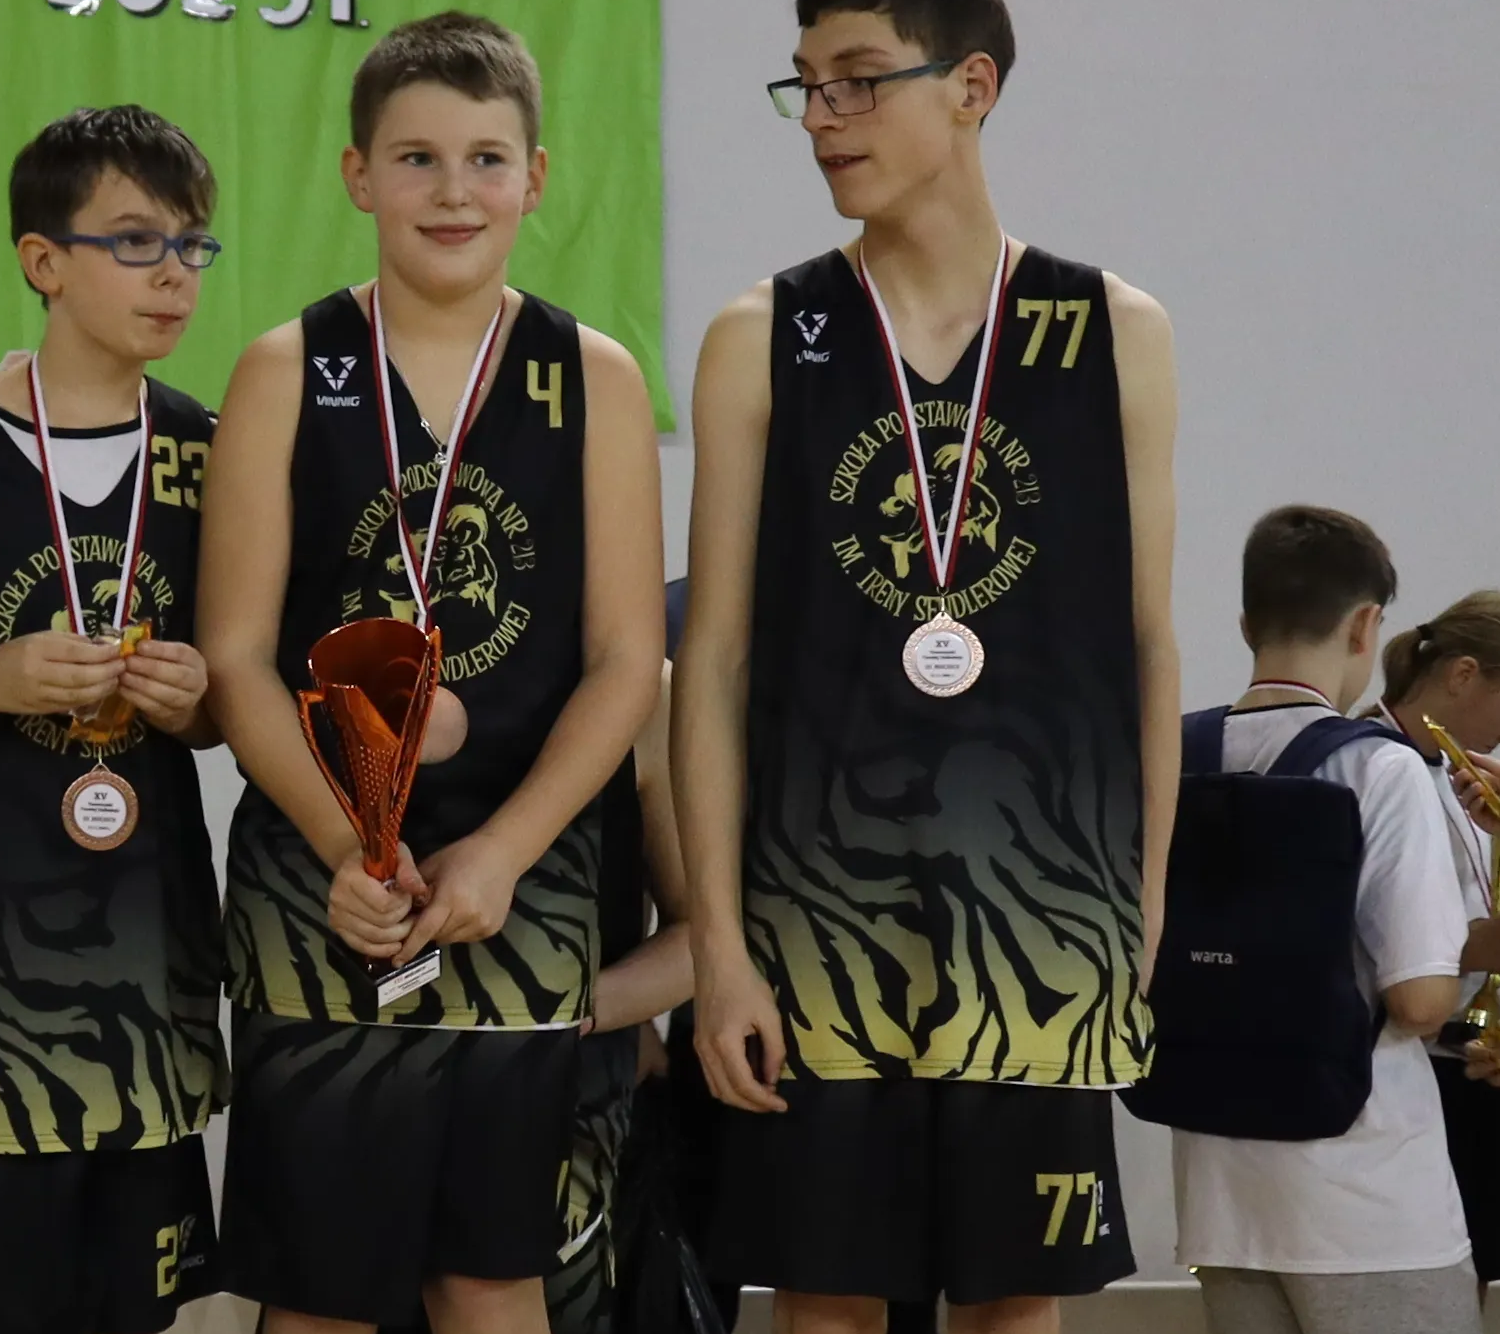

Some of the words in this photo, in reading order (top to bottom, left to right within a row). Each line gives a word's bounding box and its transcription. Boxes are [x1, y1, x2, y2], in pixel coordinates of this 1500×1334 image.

[1016, 298, 1091, 369] 77
[315, 394, 361, 408] VINNIG
[526, 359, 563, 428] 4
[829, 430, 882, 505] SZKOŁA
[999, 437, 1032, 475] NR
[347, 487, 400, 559] SZKOŁA
[495, 501, 530, 541] NR
[151, 574, 175, 612] NR
[855, 567, 912, 618] IRENY
[1034, 1171, 1098, 1247] 77
